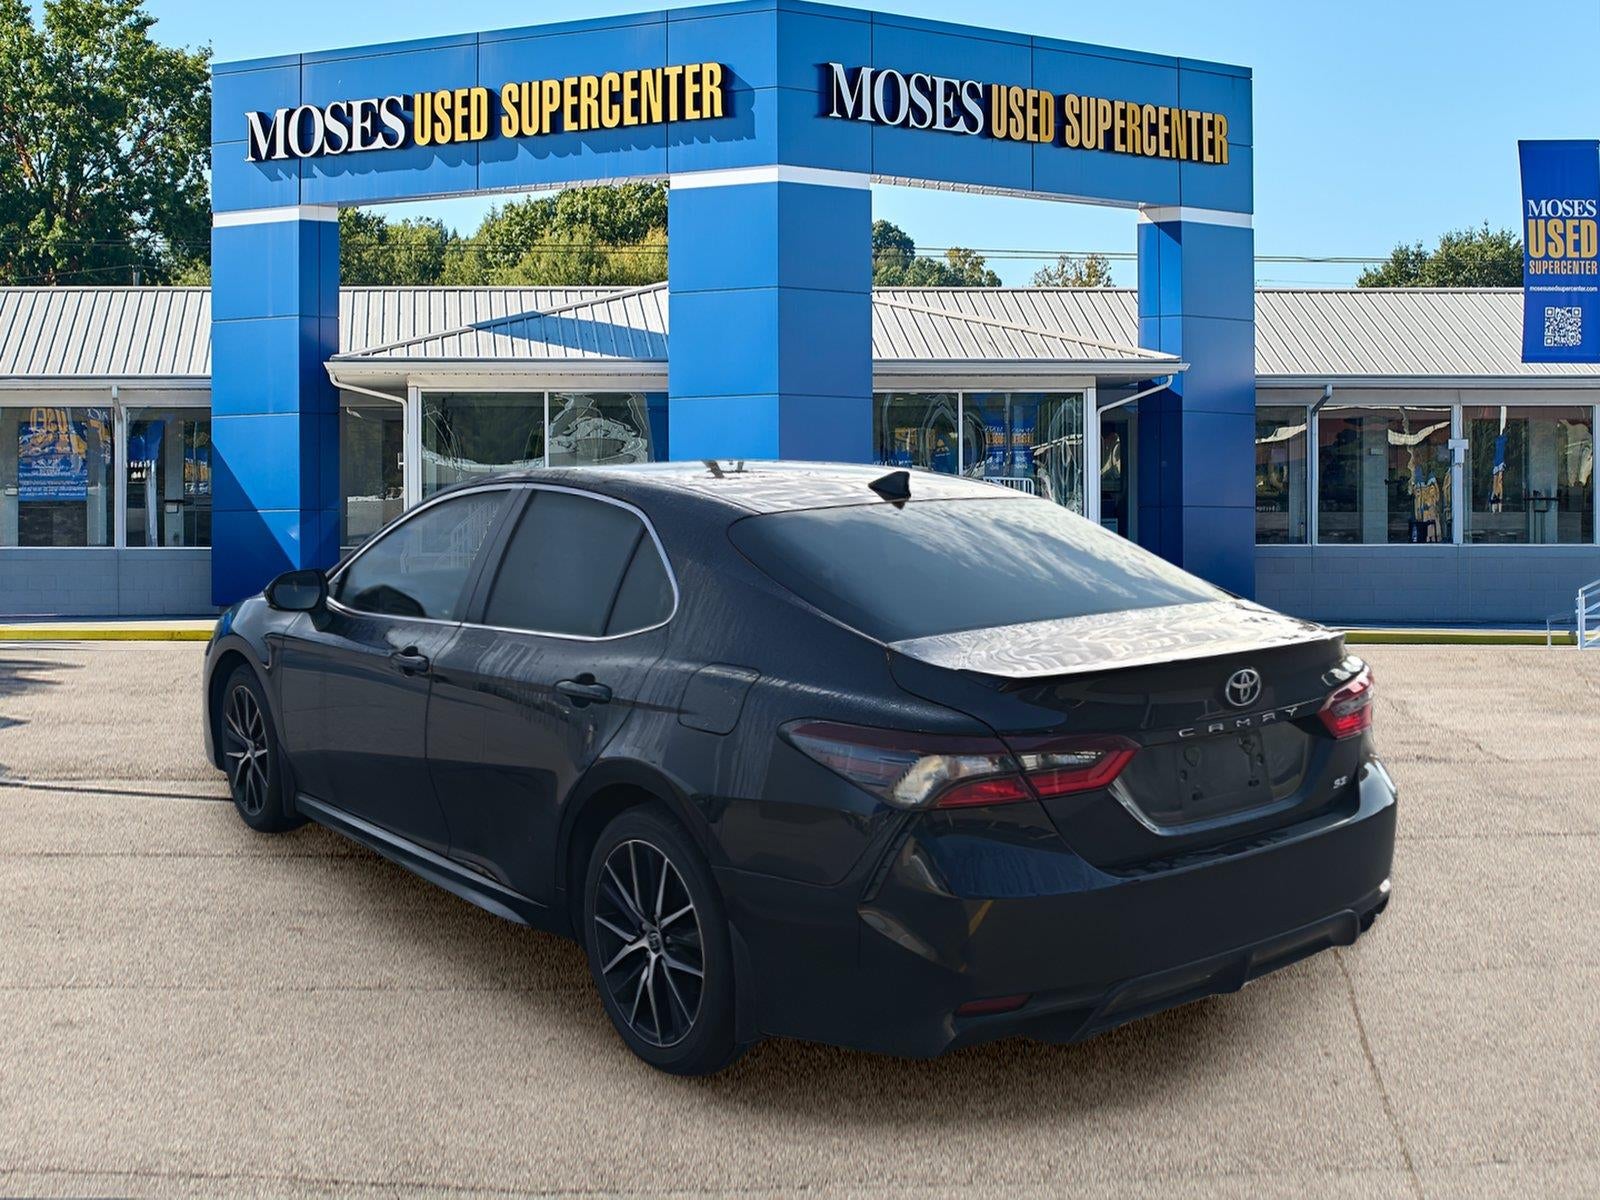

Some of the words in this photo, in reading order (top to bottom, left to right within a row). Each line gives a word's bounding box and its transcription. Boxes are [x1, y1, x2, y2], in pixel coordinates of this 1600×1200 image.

[244, 95, 406, 162] MOSES
[413, 87, 489, 146] USED
[500, 62, 724, 138] SUPERCENTER
[828, 62, 985, 136] MOSES
[990, 83, 1055, 143] USED
[1065, 93, 1230, 164] SUPERCENTER
[1528, 200, 1597, 217] MOSES
[1528, 219, 1598, 258] USED
[1529, 260, 1598, 275] SUPERCENTER
[1529, 285, 1598, 293] mosesusedsupercenter.com
[1178, 707, 1298, 738] CAMRY
